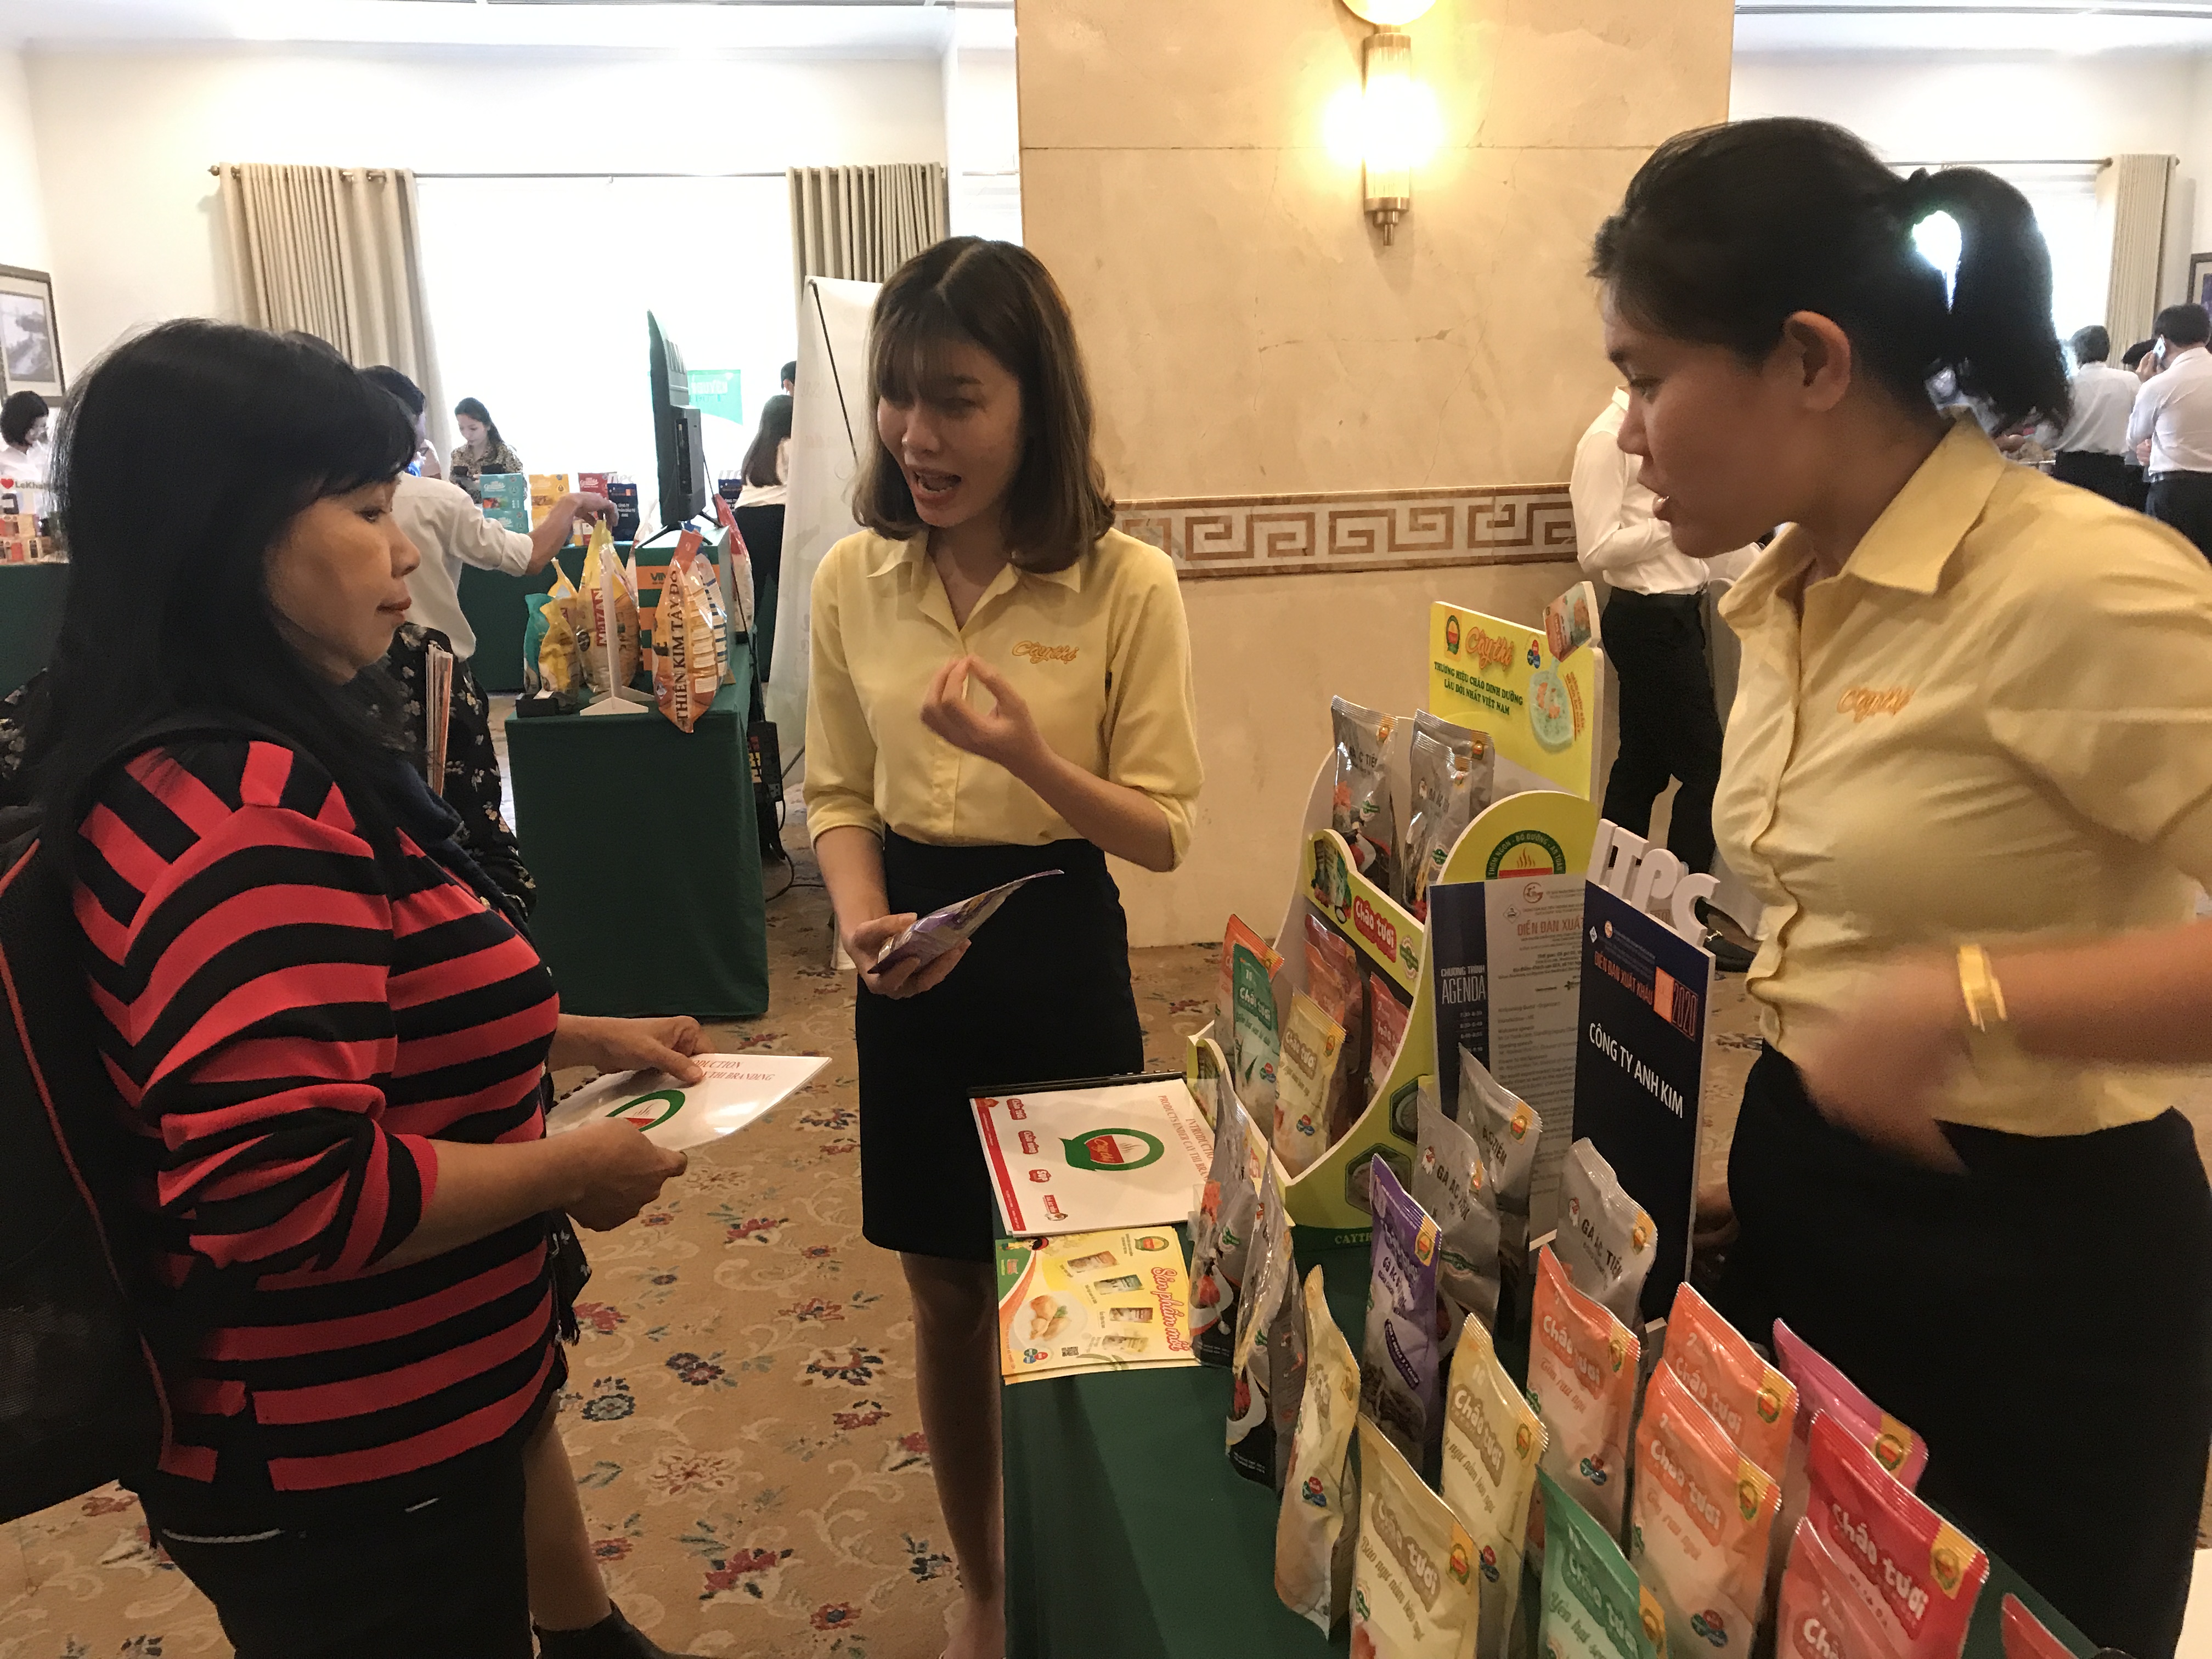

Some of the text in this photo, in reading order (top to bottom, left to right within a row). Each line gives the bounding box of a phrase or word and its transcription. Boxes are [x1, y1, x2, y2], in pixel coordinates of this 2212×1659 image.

[668, 601, 684, 631] TÂY
[672, 635, 685, 668] KIM
[1434, 661, 1523, 706] THƯƠNG HIỆU CHÁO DINH DƯỠNG
[1466, 689, 1481, 703] NHẤT
[1482, 695, 1495, 709] VIỆT
[1496, 701, 1510, 715] NAM
[1585, 819, 1720, 947] ITPC
[1355, 900, 1395, 949] Cháo tươi
[1442, 975, 1486, 1005] AGENDA
[1673, 983, 1696, 1037] 2020
[692, 1060, 744, 1069] ODUCTION
[725, 1073, 776, 1081] BRANDING
[1589, 1023, 1683, 1119] CÔNG TY ANH KIM
[1158, 1095, 1209, 1181] PRODUCTS UNDER CAY THI BRAN
[1186, 1118, 1214, 1160] INTRODUCTIO
[1436, 1165, 1449, 1186] GÀ
[1334, 1233, 1372, 1244] CAYTH
[1582, 1219, 1595, 1242] GÀ
[1150, 1267, 1191, 1351] Sản phẩm mới
[1543, 1314, 1573, 1355] Cháo
[1677, 1357, 1742, 1435] Cháo tươi
[1454, 1389, 1504, 1471] Cháo tươi
[1651, 1440, 1721, 1531] Cháo tươi
[1378, 1498, 1437, 1595] Cháo tươi
[1832, 1504, 1929, 1620] Cháo tươi
